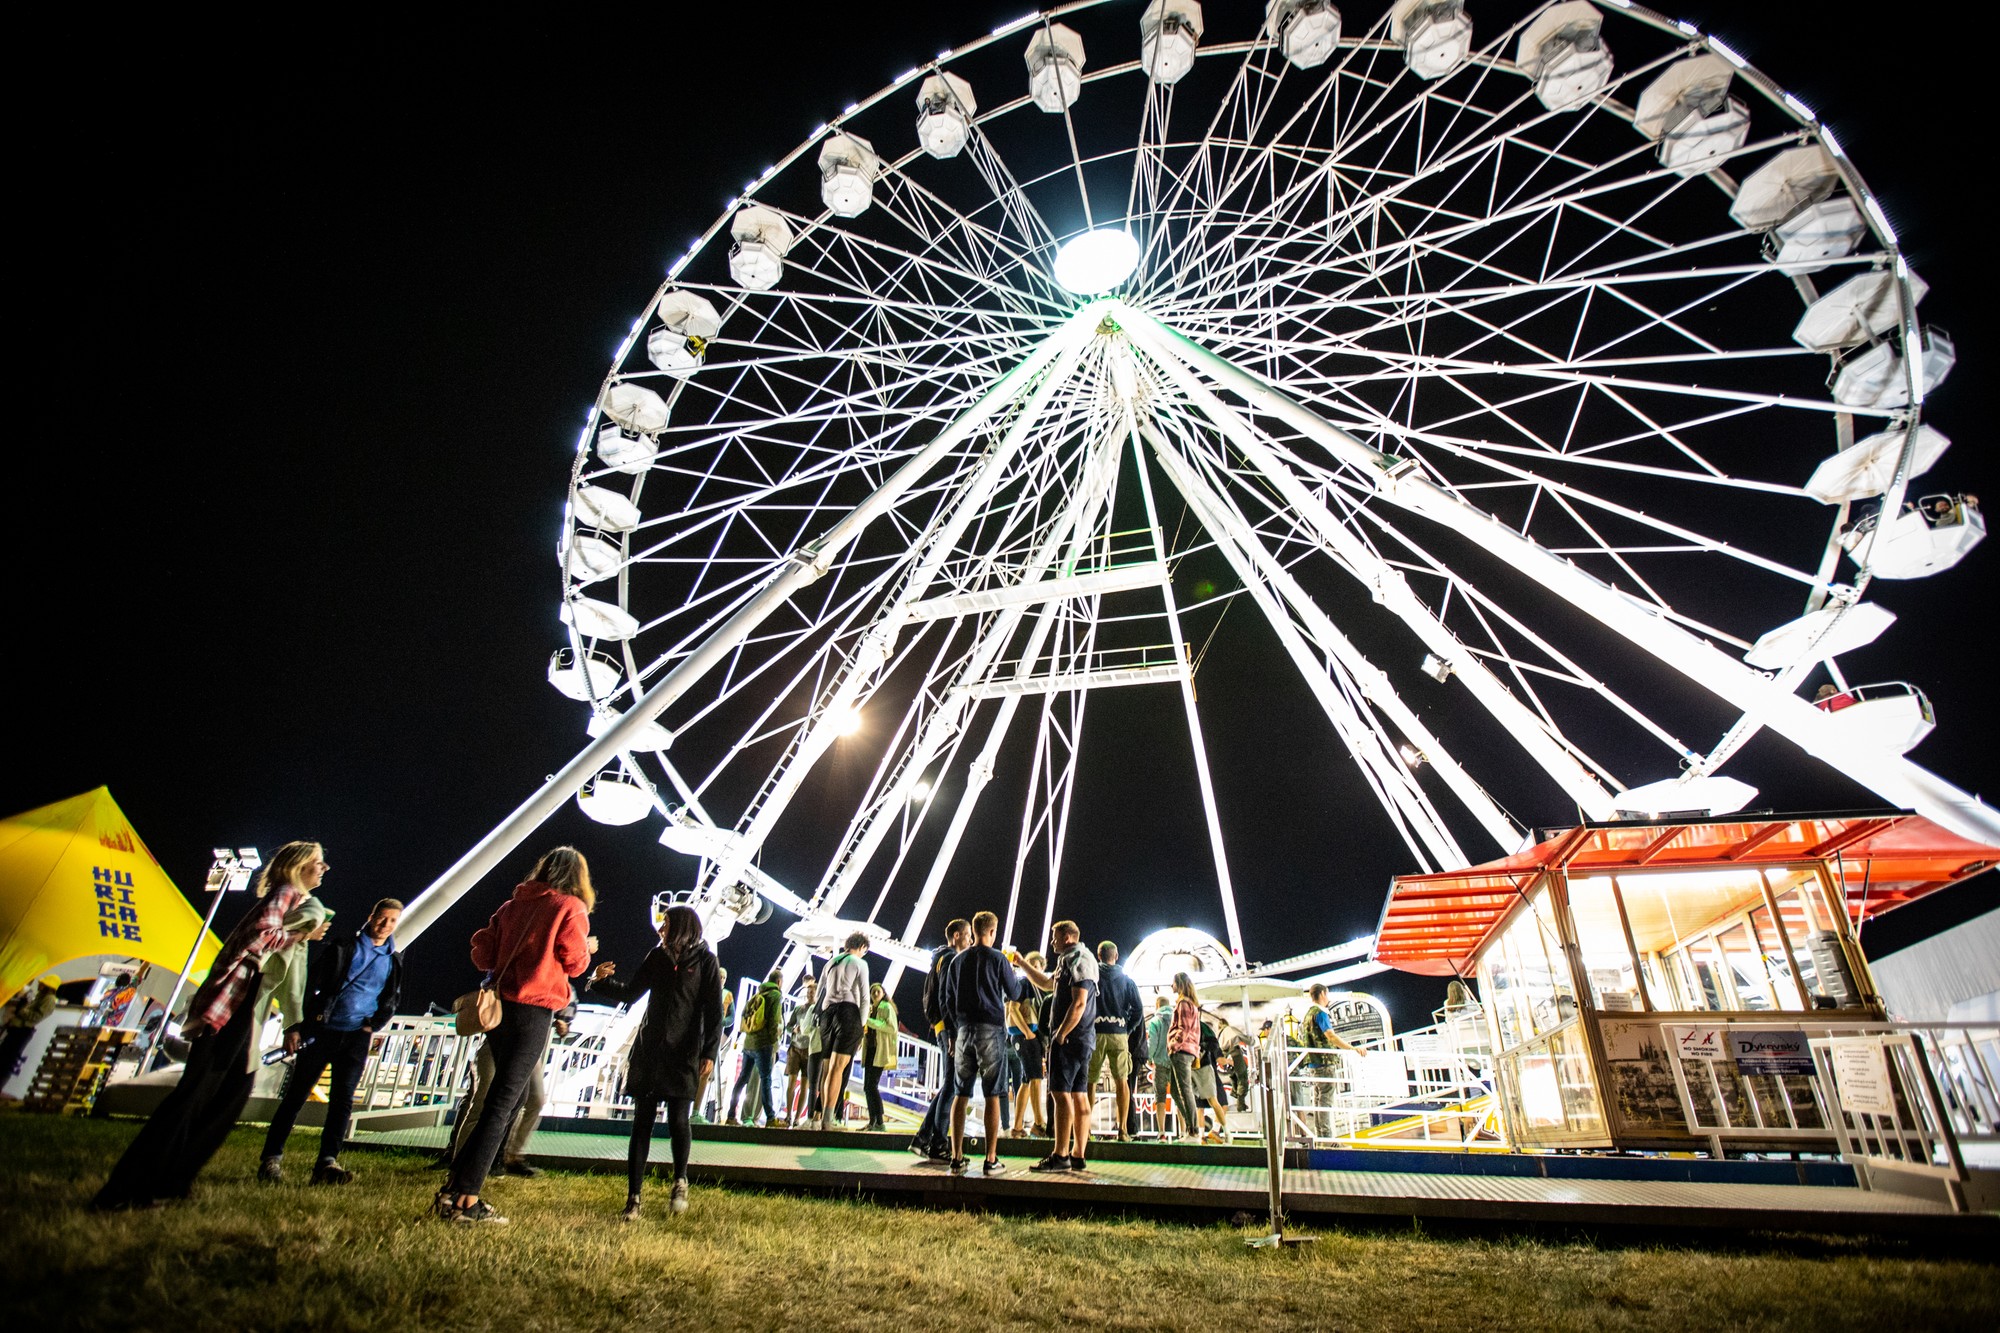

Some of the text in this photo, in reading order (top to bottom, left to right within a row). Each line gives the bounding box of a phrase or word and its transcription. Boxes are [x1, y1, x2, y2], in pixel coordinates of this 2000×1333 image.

[92, 866, 134, 887] HU
[97, 901, 138, 923] CA
[98, 920, 142, 943] NE
[1738, 1041, 1800, 1054] Dykovský
